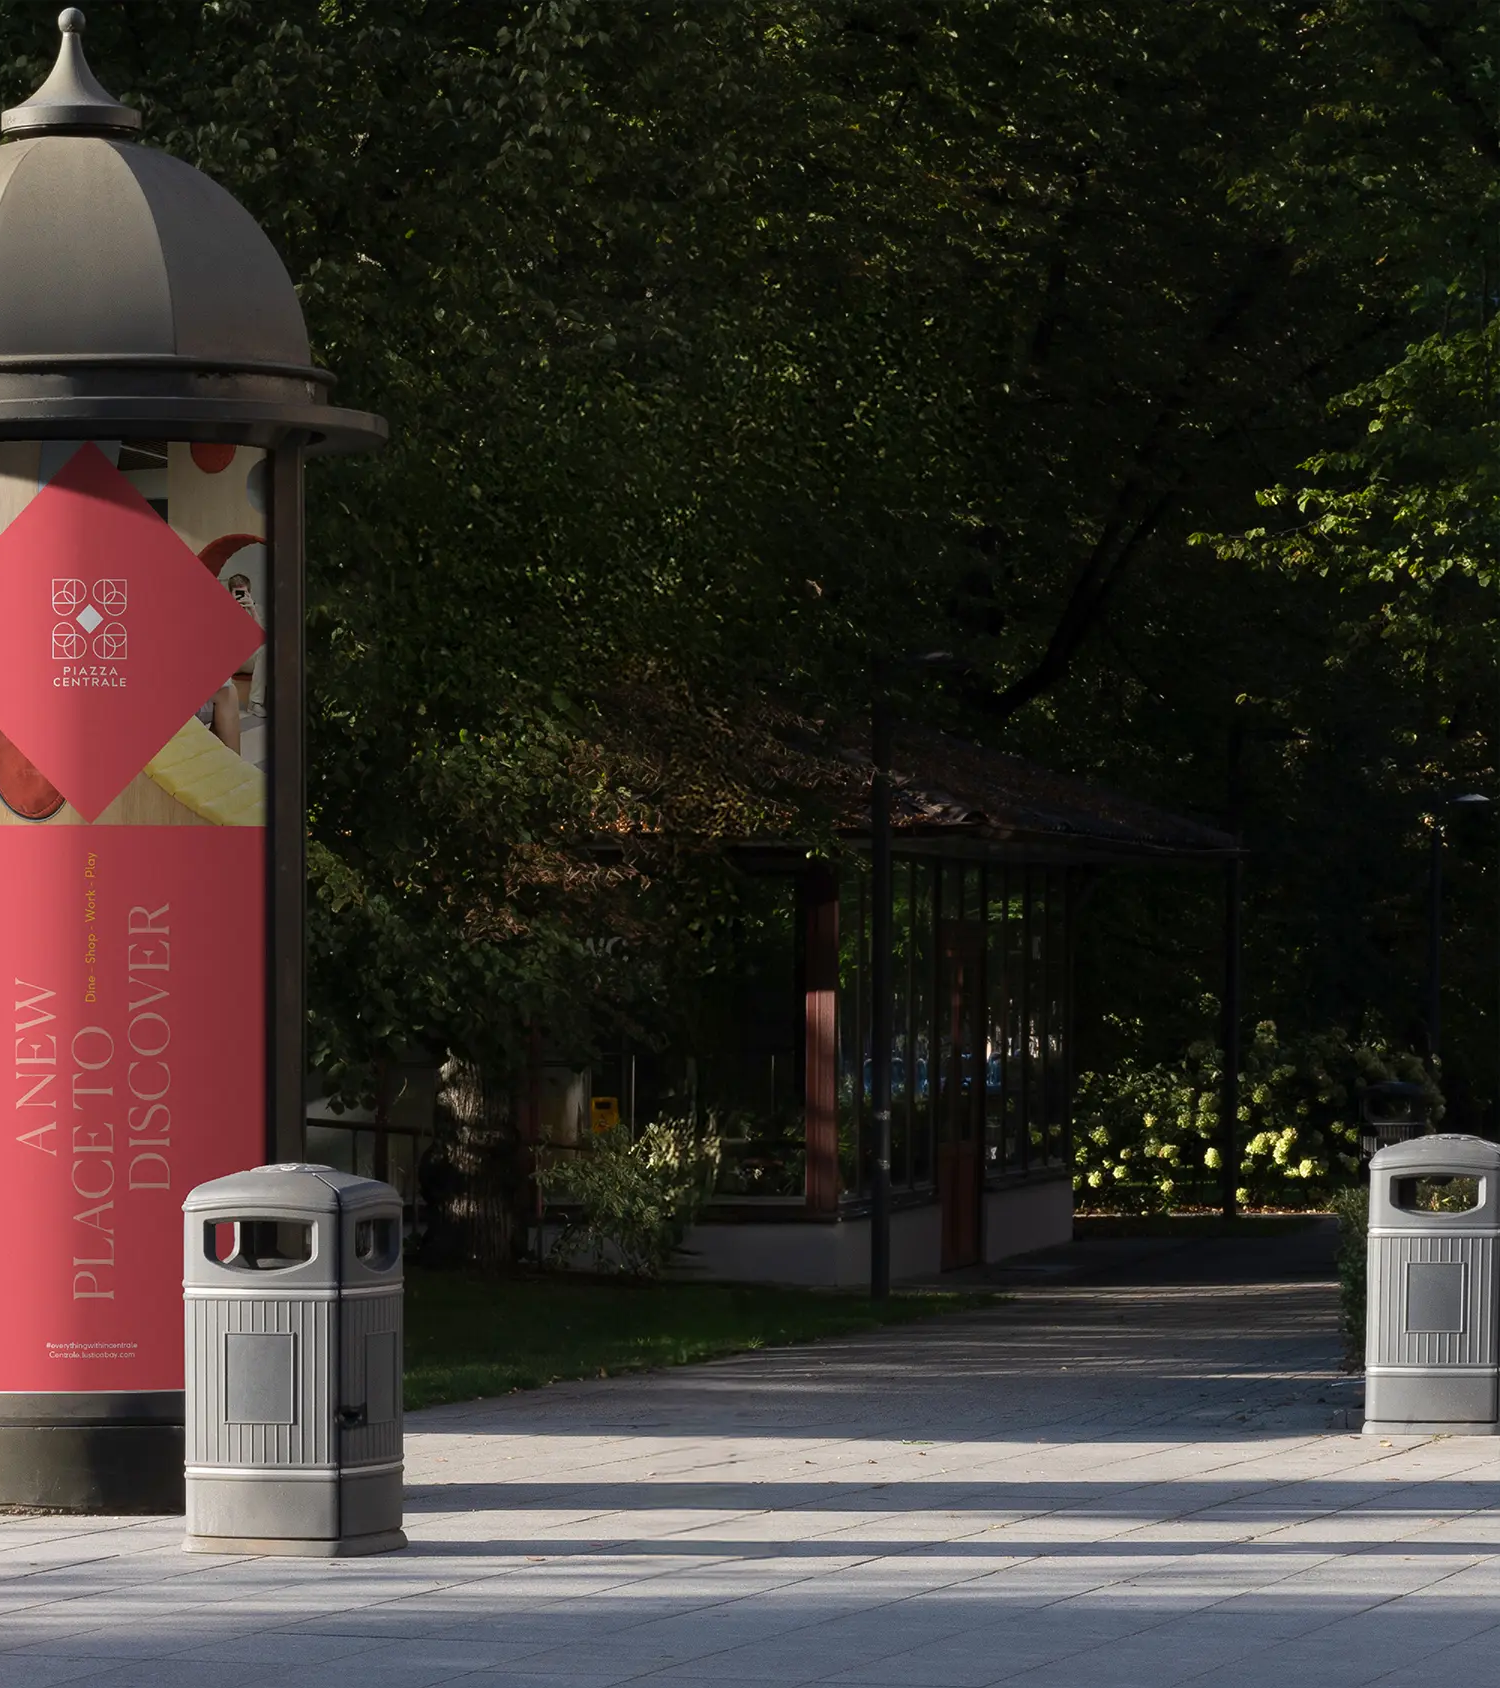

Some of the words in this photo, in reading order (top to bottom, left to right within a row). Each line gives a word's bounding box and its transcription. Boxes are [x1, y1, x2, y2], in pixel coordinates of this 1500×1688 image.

[53, 677, 127, 687] CENTRALE
[63, 666, 118, 675] PIAZZA
[85, 852, 98, 878] Play
[85, 890, 95, 922] Work
[85, 933, 98, 963] Shop
[85, 975, 96, 1002] Dine
[15, 977, 56, 1109] NEW
[128, 902, 170, 1190] DISCOVER
[71, 1026, 114, 1110] TO
[15, 1121, 57, 1157] A
[71, 1122, 114, 1300] PLACE
